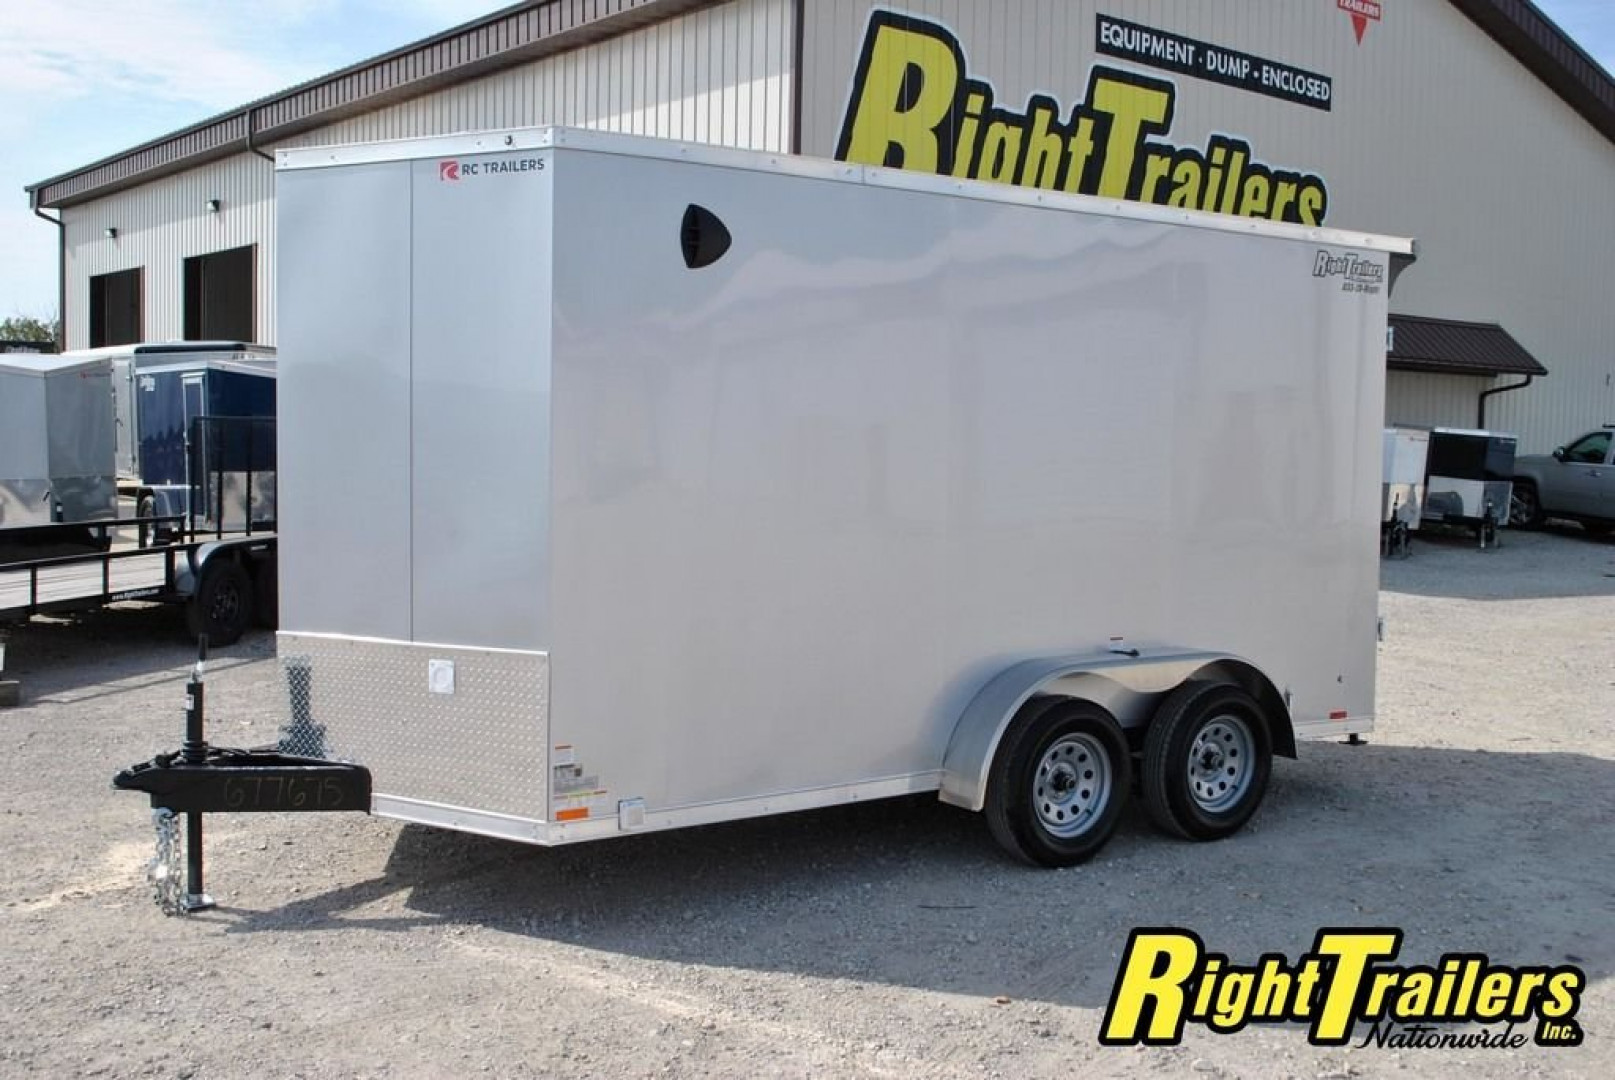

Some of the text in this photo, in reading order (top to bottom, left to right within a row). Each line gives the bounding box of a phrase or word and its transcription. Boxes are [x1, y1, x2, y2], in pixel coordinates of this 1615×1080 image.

[1100, 21, 1330, 101] EQUIPMENT DUMP ENCLOSED
[461, 158, 545, 176] RC TRAILERS
[223, 775, 345, 808] 677675
